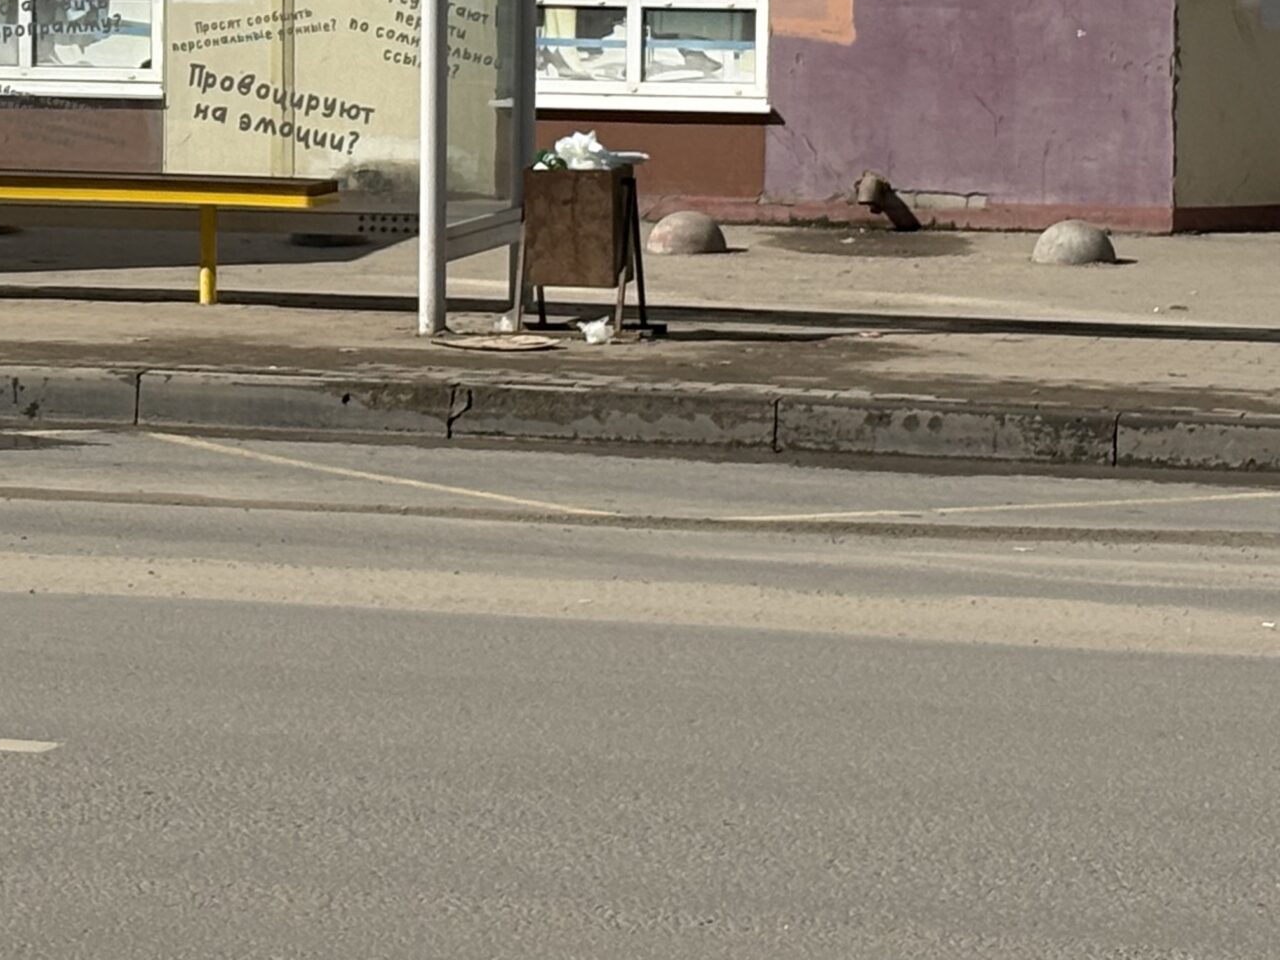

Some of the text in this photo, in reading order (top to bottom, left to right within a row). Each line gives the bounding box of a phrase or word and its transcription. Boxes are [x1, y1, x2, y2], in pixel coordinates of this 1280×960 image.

[195, 18, 242, 35] Просят
[349, 17, 369, 33] по
[172, 30, 273, 52] персональные
[189, 63, 375, 125] Провоцируют
[194, 103, 361, 156] на эмоции?
